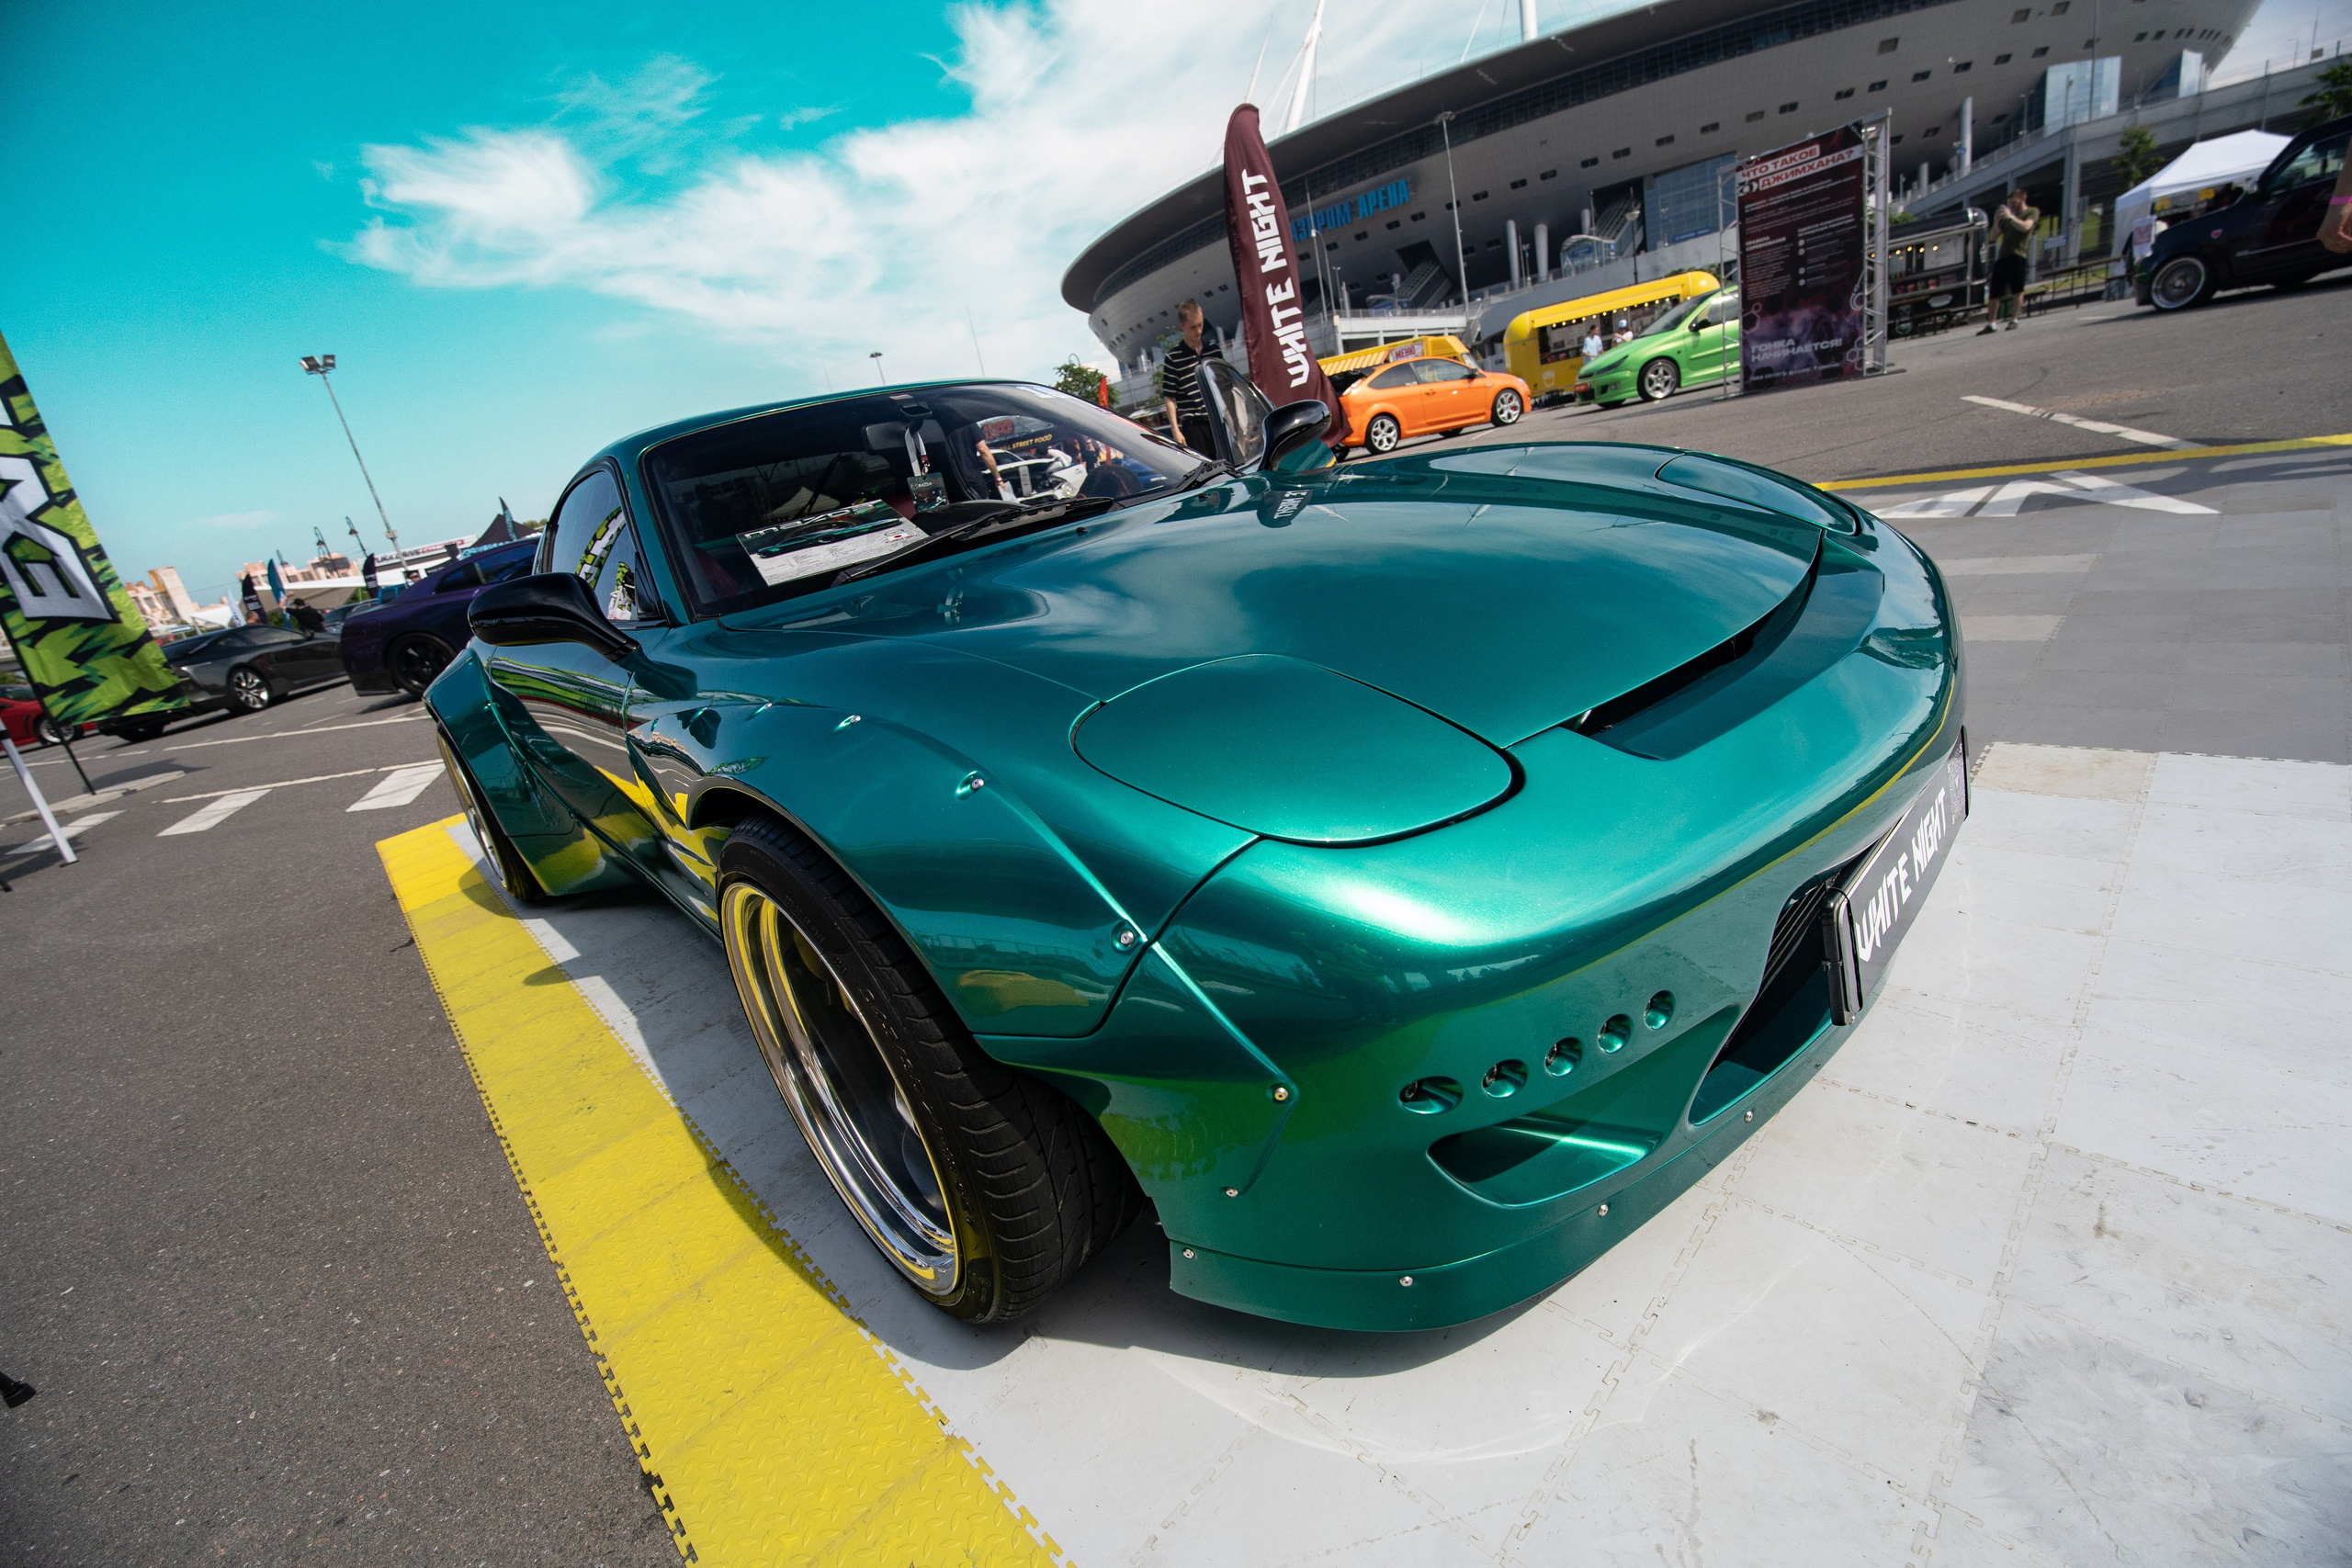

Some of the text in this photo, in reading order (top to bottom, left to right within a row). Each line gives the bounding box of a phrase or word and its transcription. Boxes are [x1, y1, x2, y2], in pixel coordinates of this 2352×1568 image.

[1741, 147, 1818, 179] ЧТО ТАКОЕ
[1760, 149, 1854, 188] ДЖИМХАНА?
[1289, 179, 1410, 243] АЗПРОМ АРЕНА
[1241, 169, 1309, 388] WHITE NIGHT
[1751, 338, 1795, 354] ГОНКА
[1751, 337, 1843, 363] НАЧИНАЕТСЯ!
[1012, 438, 1034, 449] STREET
[1035, 434, 1053, 445] FOOD
[1854, 786, 1947, 963] WHITE NIGHT
